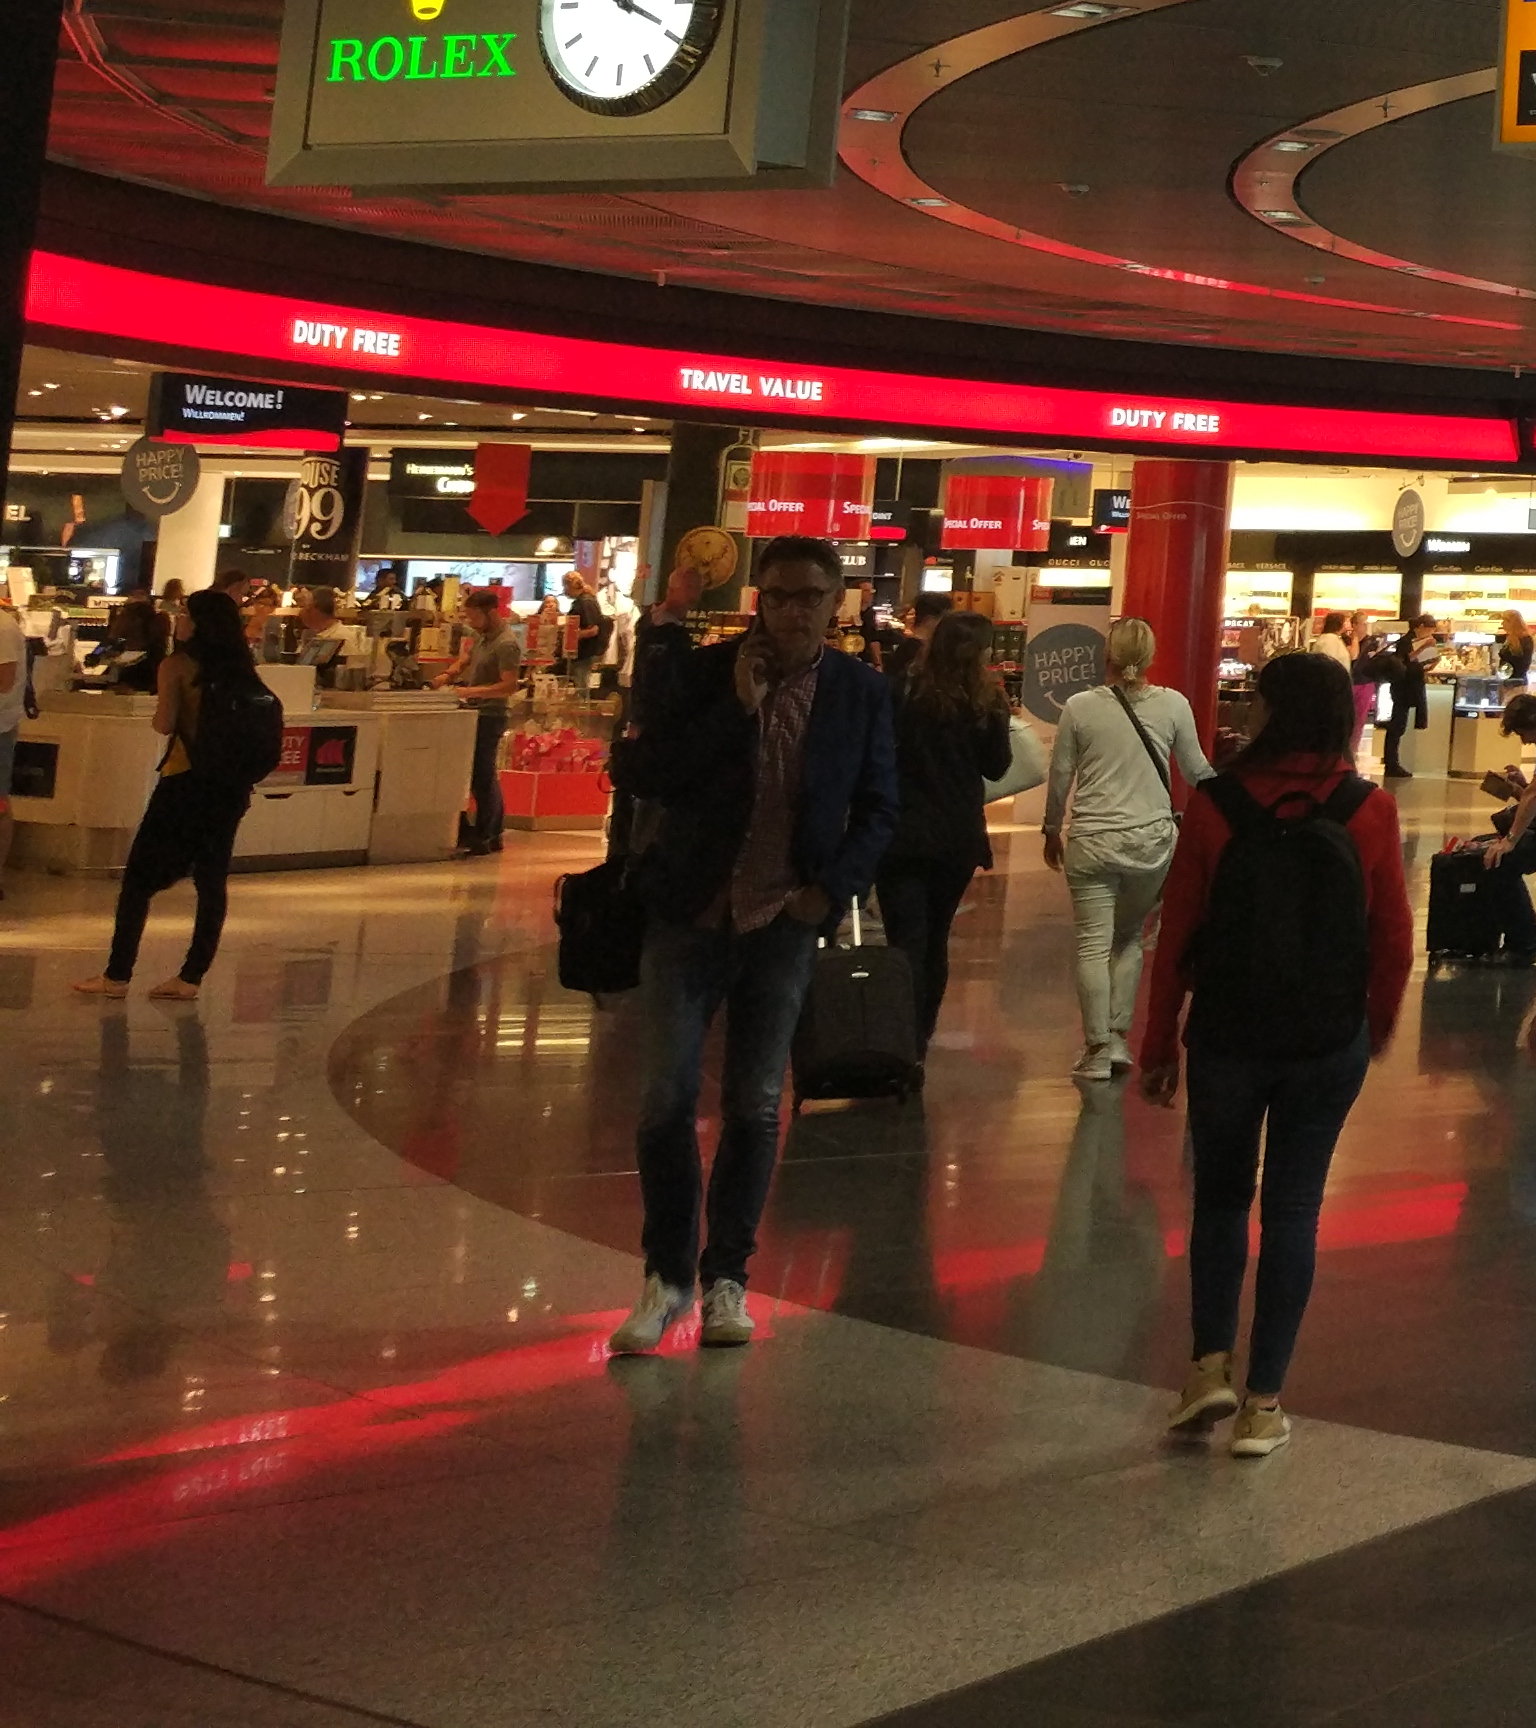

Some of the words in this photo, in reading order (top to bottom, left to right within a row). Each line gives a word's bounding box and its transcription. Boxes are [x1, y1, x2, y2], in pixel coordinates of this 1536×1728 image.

[326, 32, 517, 83] ROLEX
[292, 318, 349, 350] DUTY
[352, 327, 401, 357] FREE
[680, 367, 753, 396] TRAVEL
[759, 375, 824, 401] VALUE
[1111, 407, 1167, 431] DUTY
[1171, 411, 1220, 433] FREE
[136, 446, 187, 469] HAPPY
[302, 458, 341, 488] OUSE
[1034, 643, 1098, 670] HAPPY
[1037, 662, 1097, 689] PRICE!
